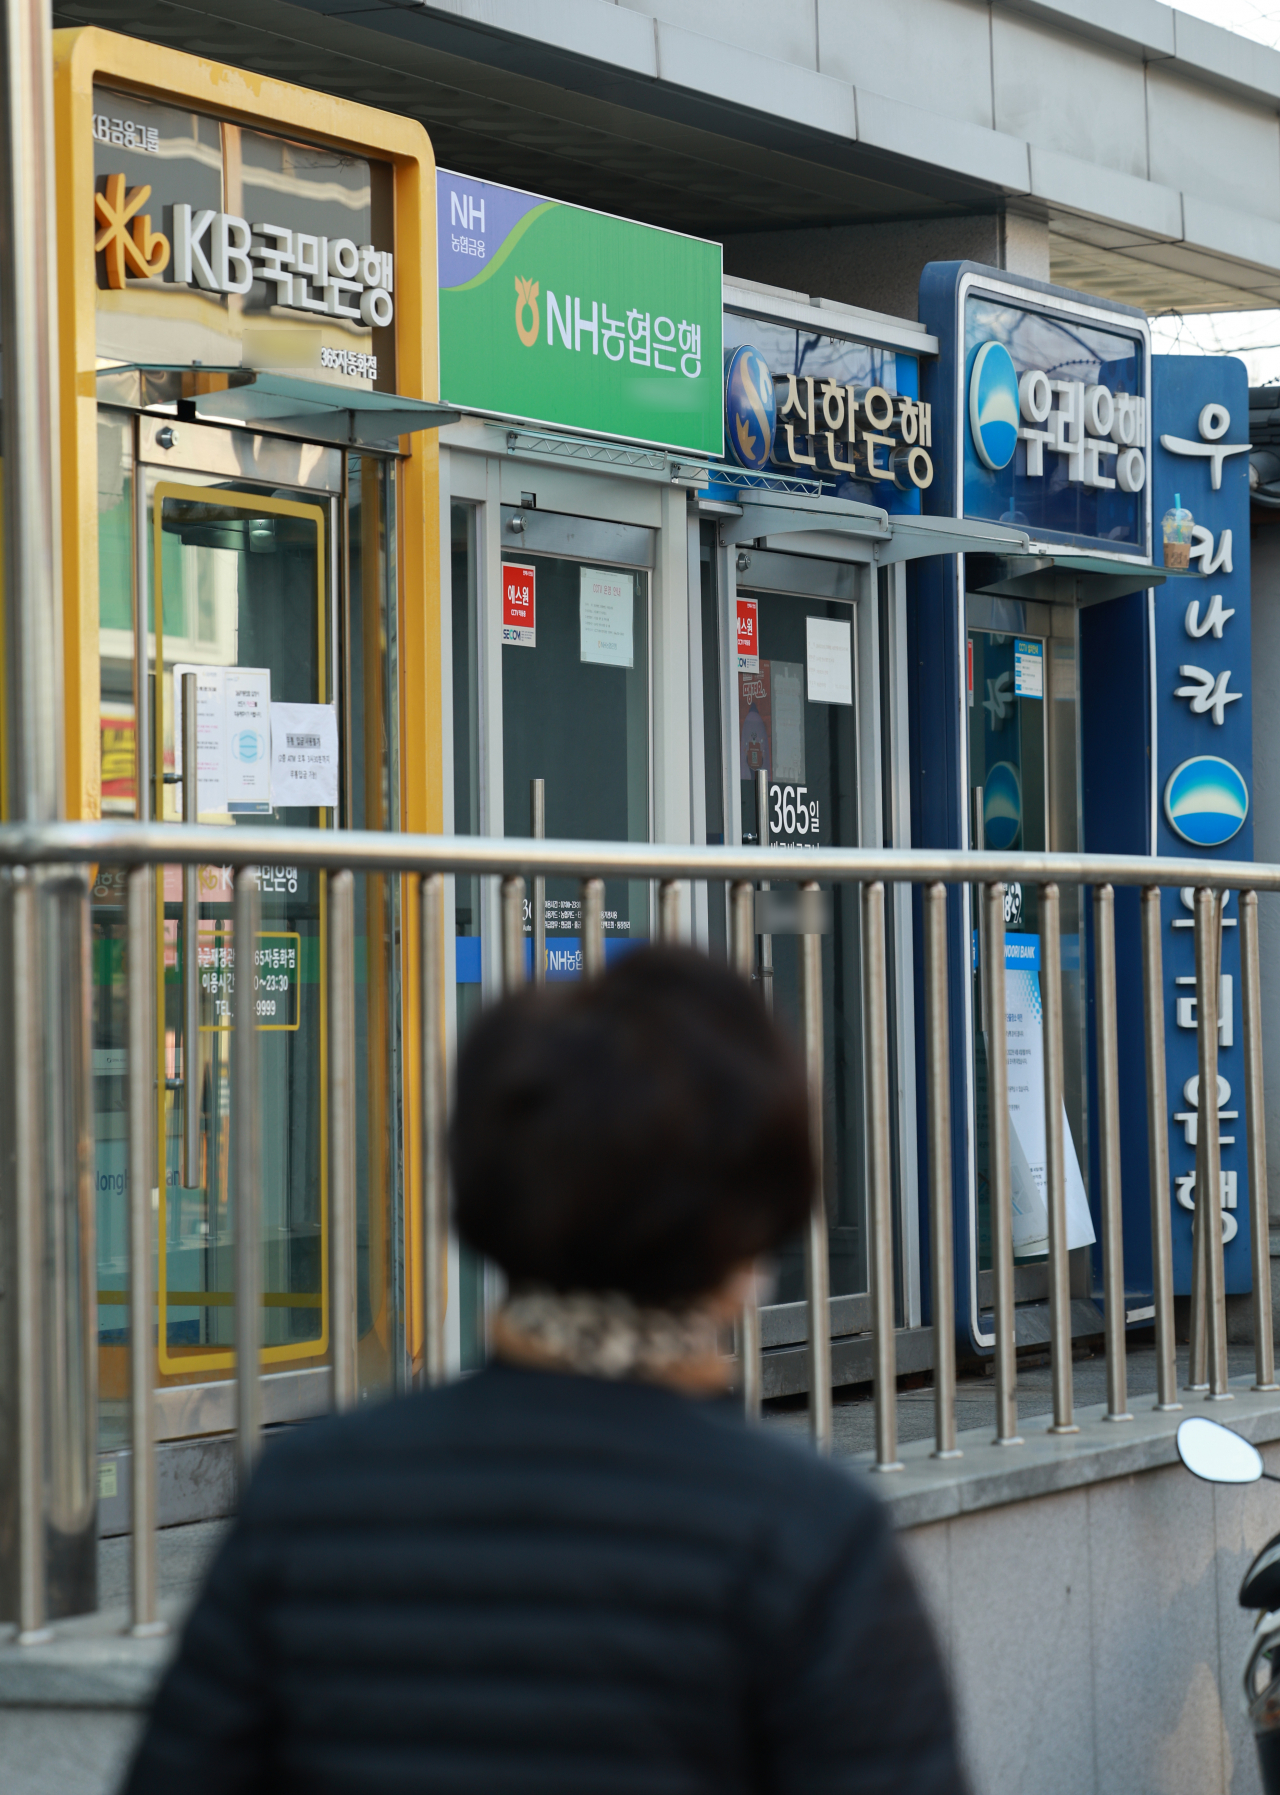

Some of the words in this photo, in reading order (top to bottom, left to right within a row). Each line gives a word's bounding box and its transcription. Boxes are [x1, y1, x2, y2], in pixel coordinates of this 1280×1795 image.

[451, 190, 485, 233] NH
[452, 234, 485, 258] 농협금융
[173, 203, 393, 327] KB국민은행
[547, 290, 701, 379] NH농협은행
[321, 346, 377, 380] 365자동화점
[781, 373, 934, 489] 신한은행
[1017, 370, 1146, 492] 우리은행
[1160, 402, 1253, 726] 우리나라
[507, 585, 529, 606] 에스원
[503, 629, 521, 641] SECOM
[769, 784, 820, 835] 365일
[222, 864, 298, 893] K국민은행
[254, 948, 295, 969] 65자동화점
[1020, 945, 1035, 959] BANK
[254, 974, 289, 991] 0~23:30
[252, 1000, 277, 1016] -9999
